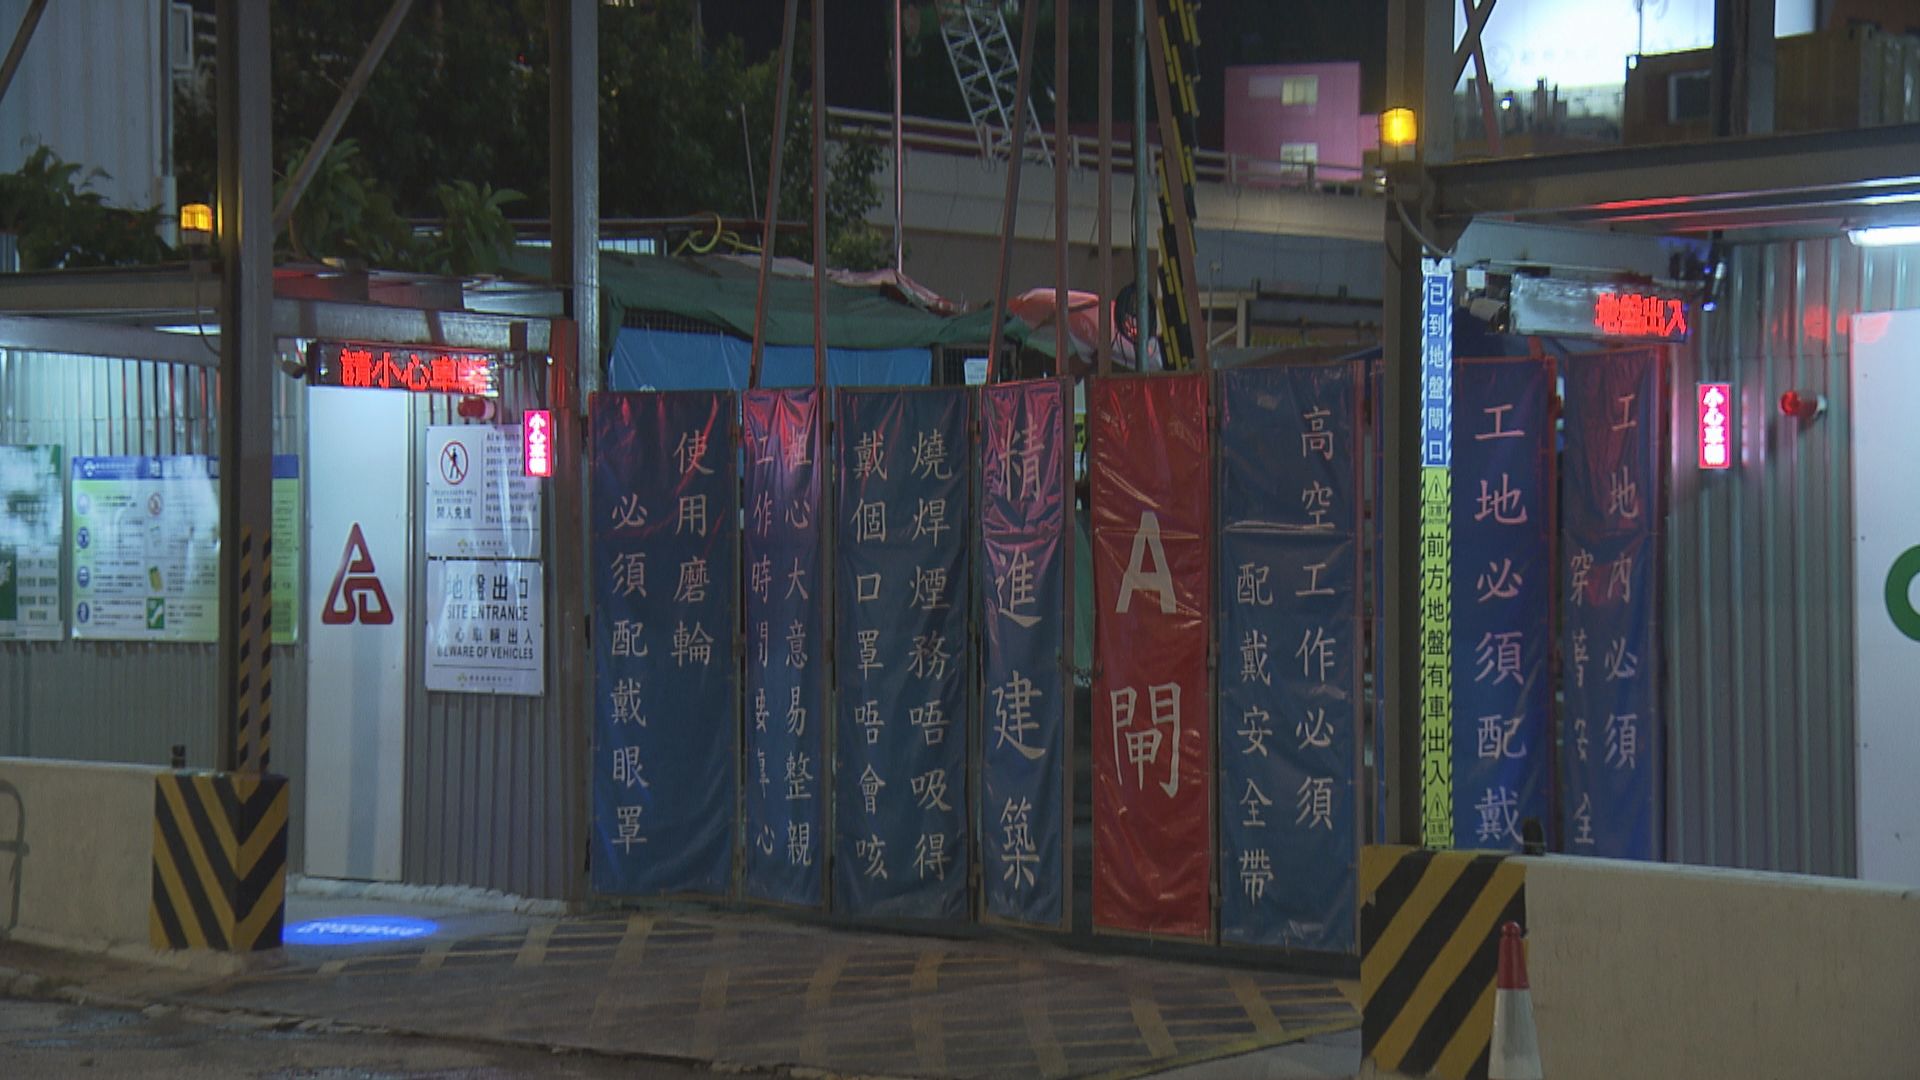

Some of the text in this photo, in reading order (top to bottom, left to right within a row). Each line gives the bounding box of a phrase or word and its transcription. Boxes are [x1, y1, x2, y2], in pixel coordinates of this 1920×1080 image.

[1427, 282, 1446, 462] 已到地盤閘口
[437, 645, 534, 660] BEWARE OF VEHICLES
[447, 604, 529, 621] SITE ENTRANCE
[610, 491, 650, 852] 必須配戴眼罩
[670, 430, 715, 668] 使用磨輪
[850, 431, 888, 880] 戴個口罩唔會咳
[991, 415, 1047, 892] 精進建築
[1294, 406, 1337, 832] 高空工作必須
[1426, 531, 1447, 786] 前方地盤有車出入
[1473, 403, 1528, 846] 工地必須配戴
[1236, 561, 1275, 905] 配戴安全帶
